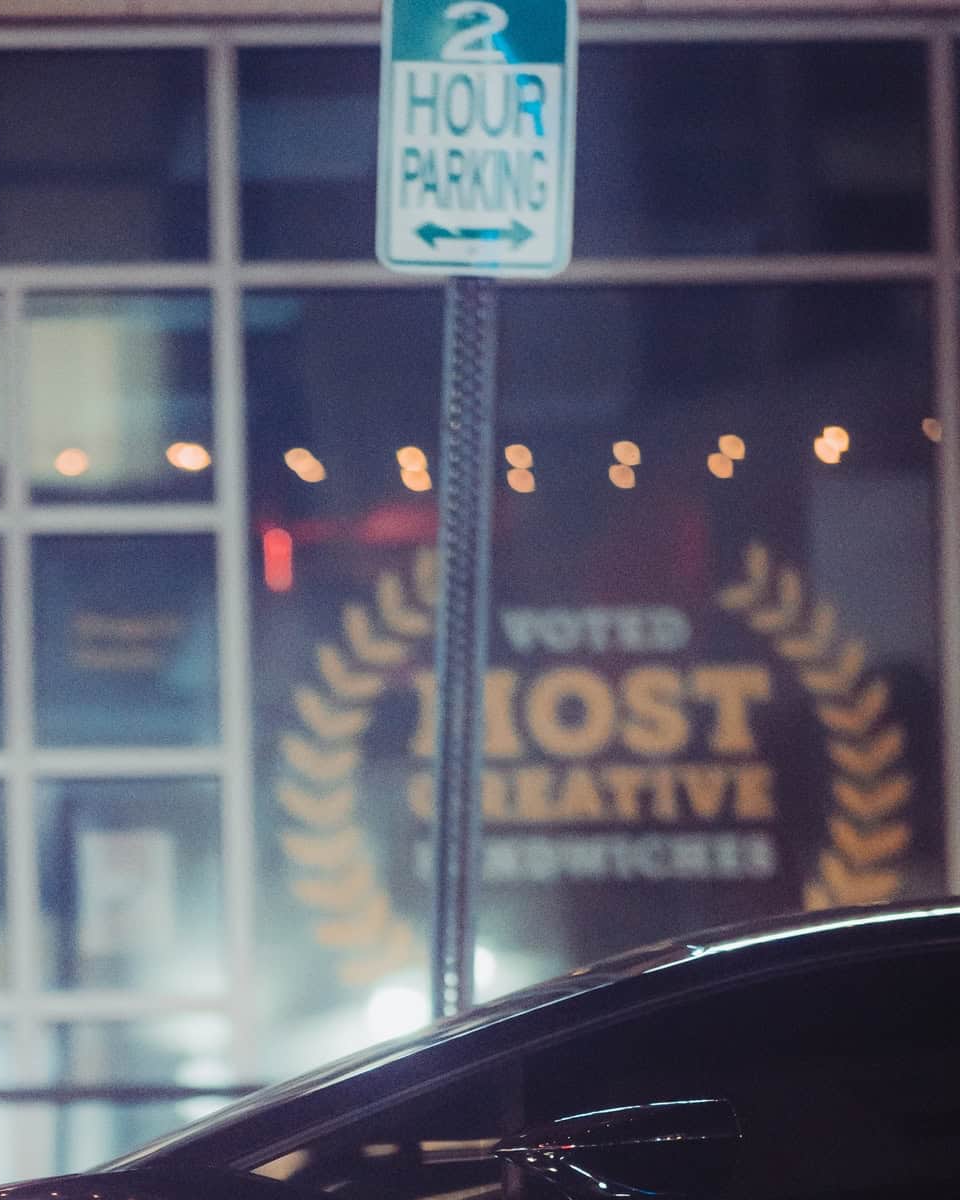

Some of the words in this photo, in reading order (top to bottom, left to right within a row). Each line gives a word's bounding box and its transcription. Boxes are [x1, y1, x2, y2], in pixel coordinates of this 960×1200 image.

[441, 1, 509, 62] 2
[406, 72, 546, 137] HOUR
[400, 148, 547, 212] PARKING
[501, 607, 692, 652] VOTED
